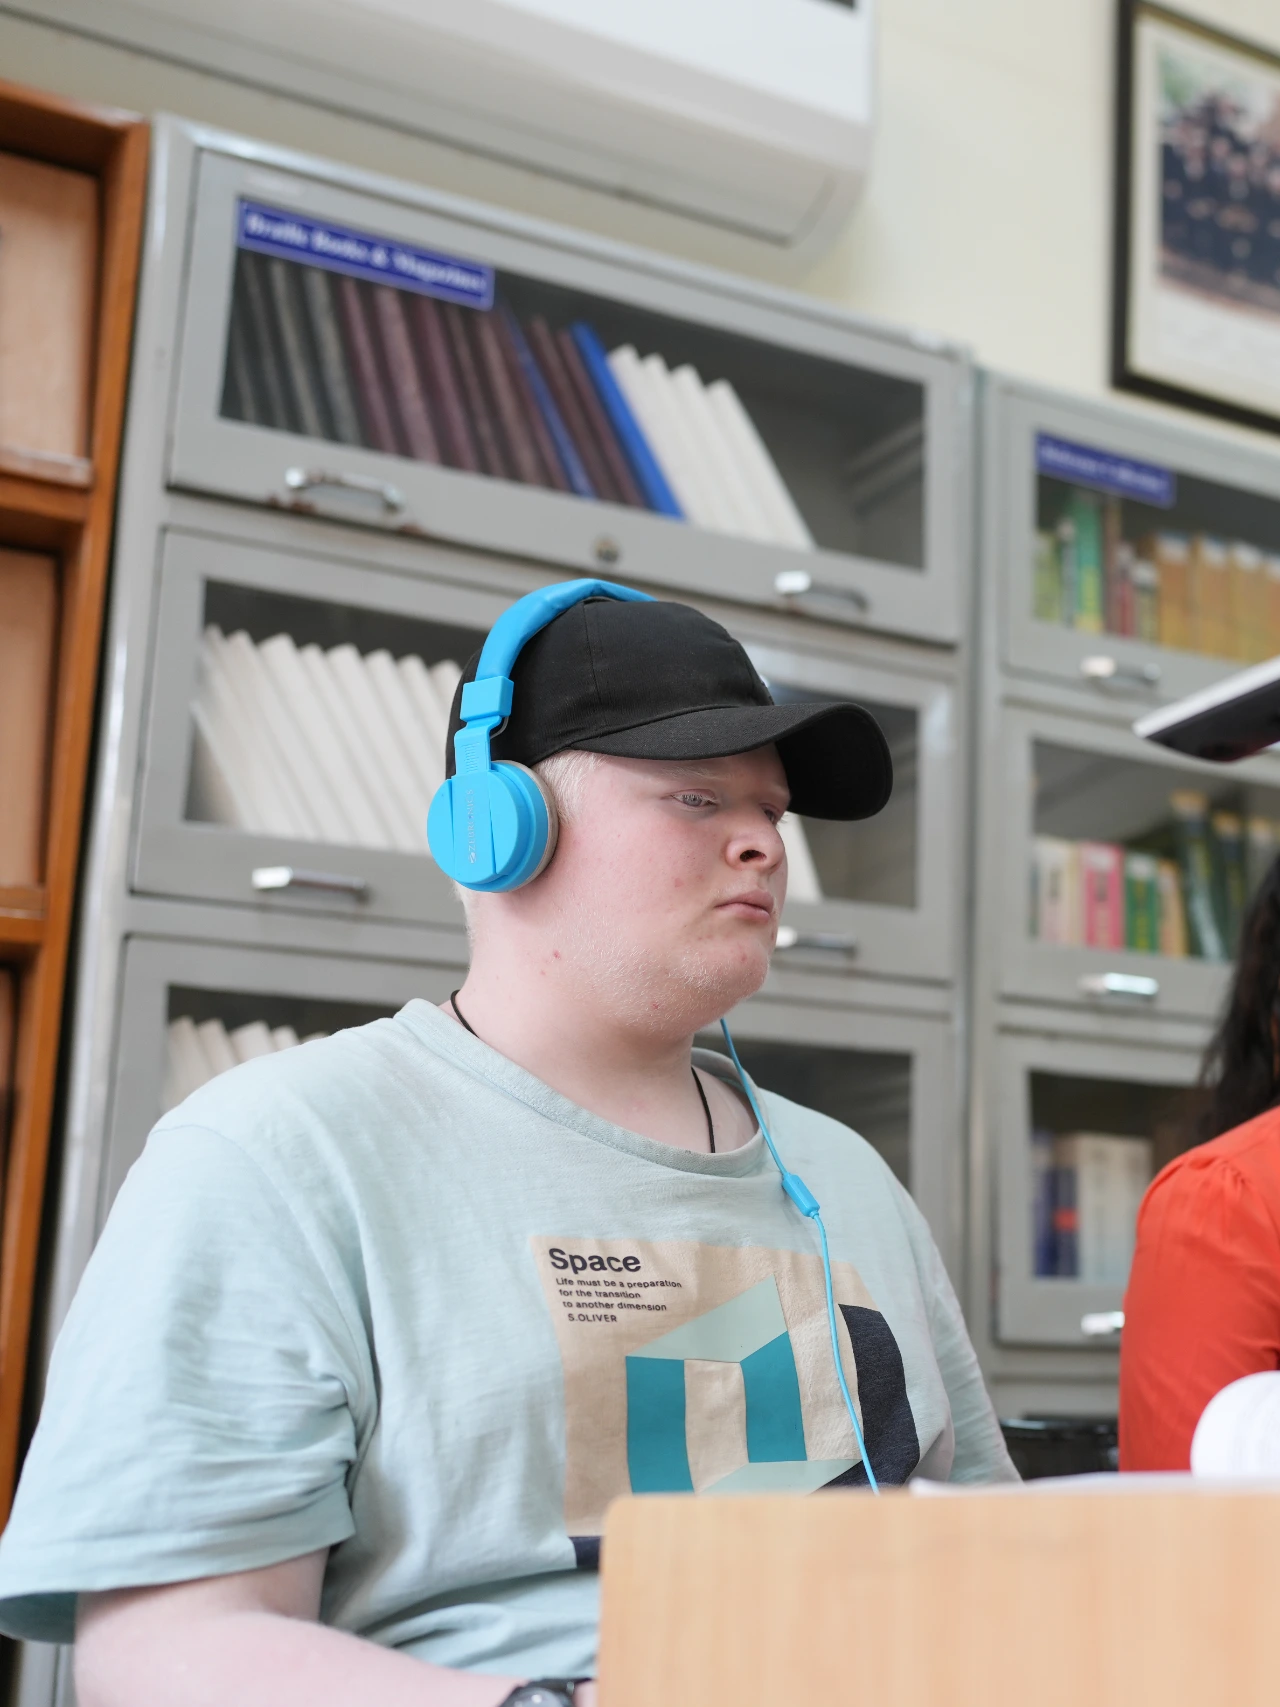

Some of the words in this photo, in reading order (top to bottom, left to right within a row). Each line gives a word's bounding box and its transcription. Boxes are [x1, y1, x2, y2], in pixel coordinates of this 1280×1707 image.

[549, 1248, 641, 1274] Space
[555, 1277, 575, 1286] Life
[576, 1279, 601, 1287] must
[603, 1279, 617, 1287] be
[626, 1279, 682, 1289] preparation
[558, 1289, 573, 1297] for
[575, 1289, 592, 1297] the
[594, 1290, 641, 1299] transition
[575, 1301, 614, 1309] another
[616, 1301, 667, 1311] dimension
[567, 1312, 618, 1323] S.OLIVER
